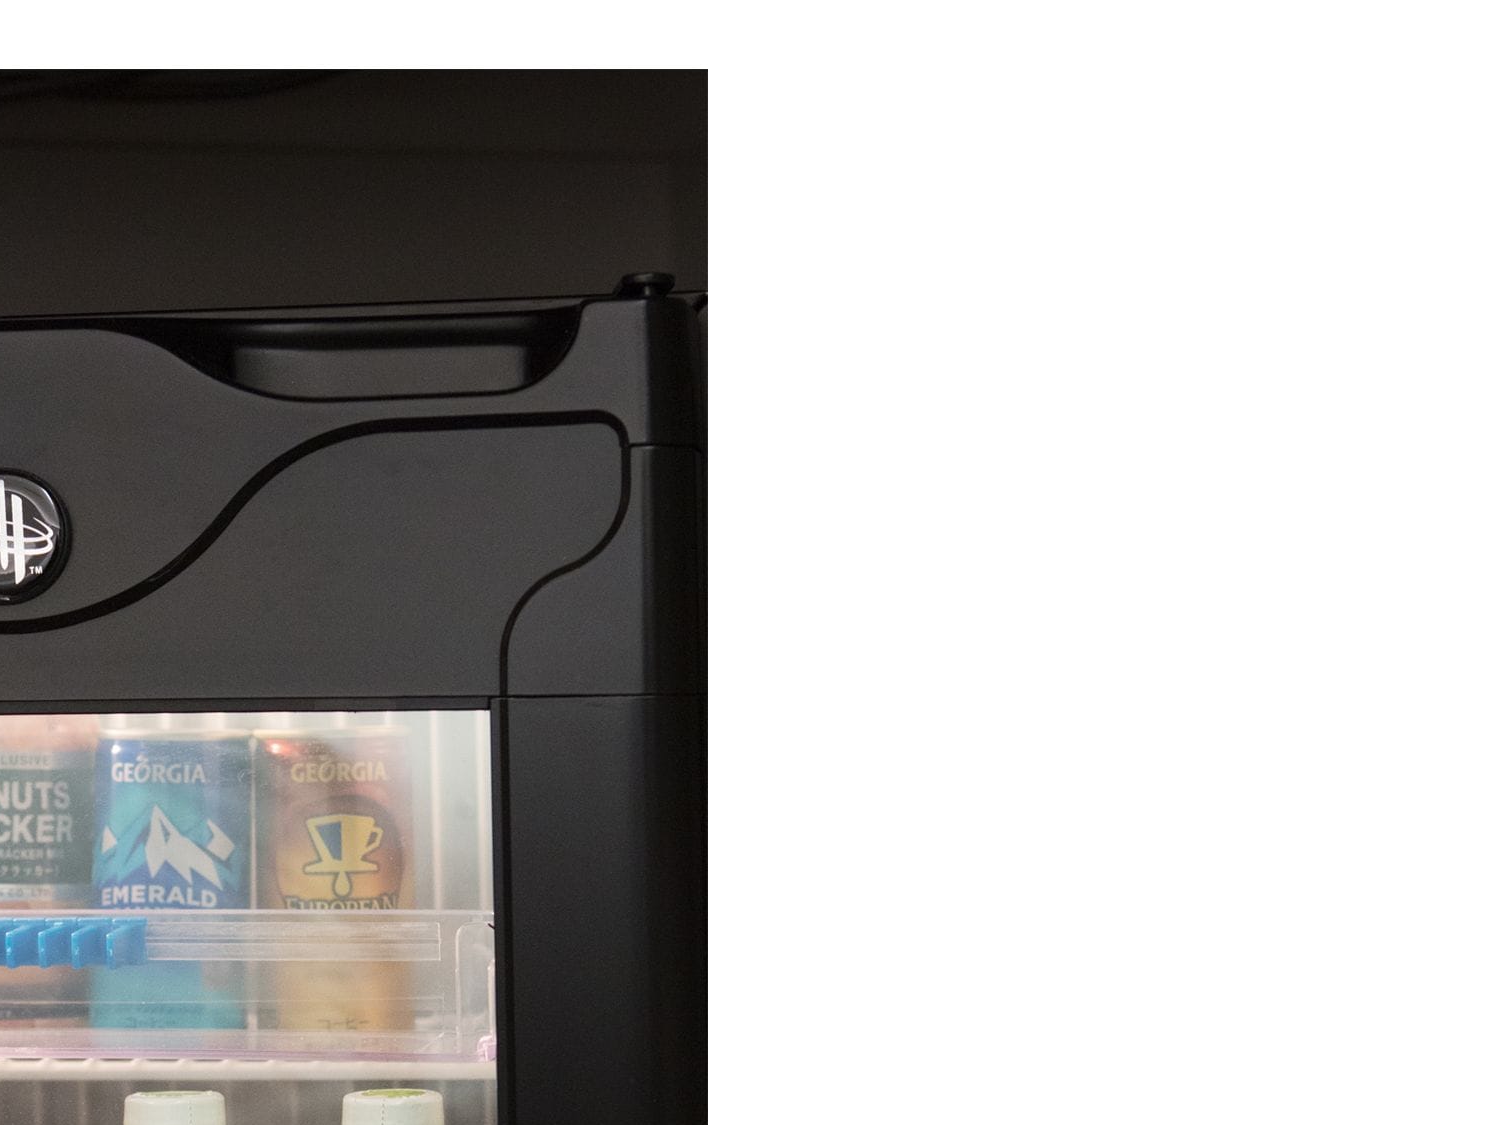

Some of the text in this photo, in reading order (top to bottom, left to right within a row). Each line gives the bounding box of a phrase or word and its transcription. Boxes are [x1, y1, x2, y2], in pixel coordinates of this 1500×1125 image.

[111, 756, 207, 784] GEORGIA
[291, 756, 388, 783] GEORGIA
[101, 884, 217, 908] EMERALD
